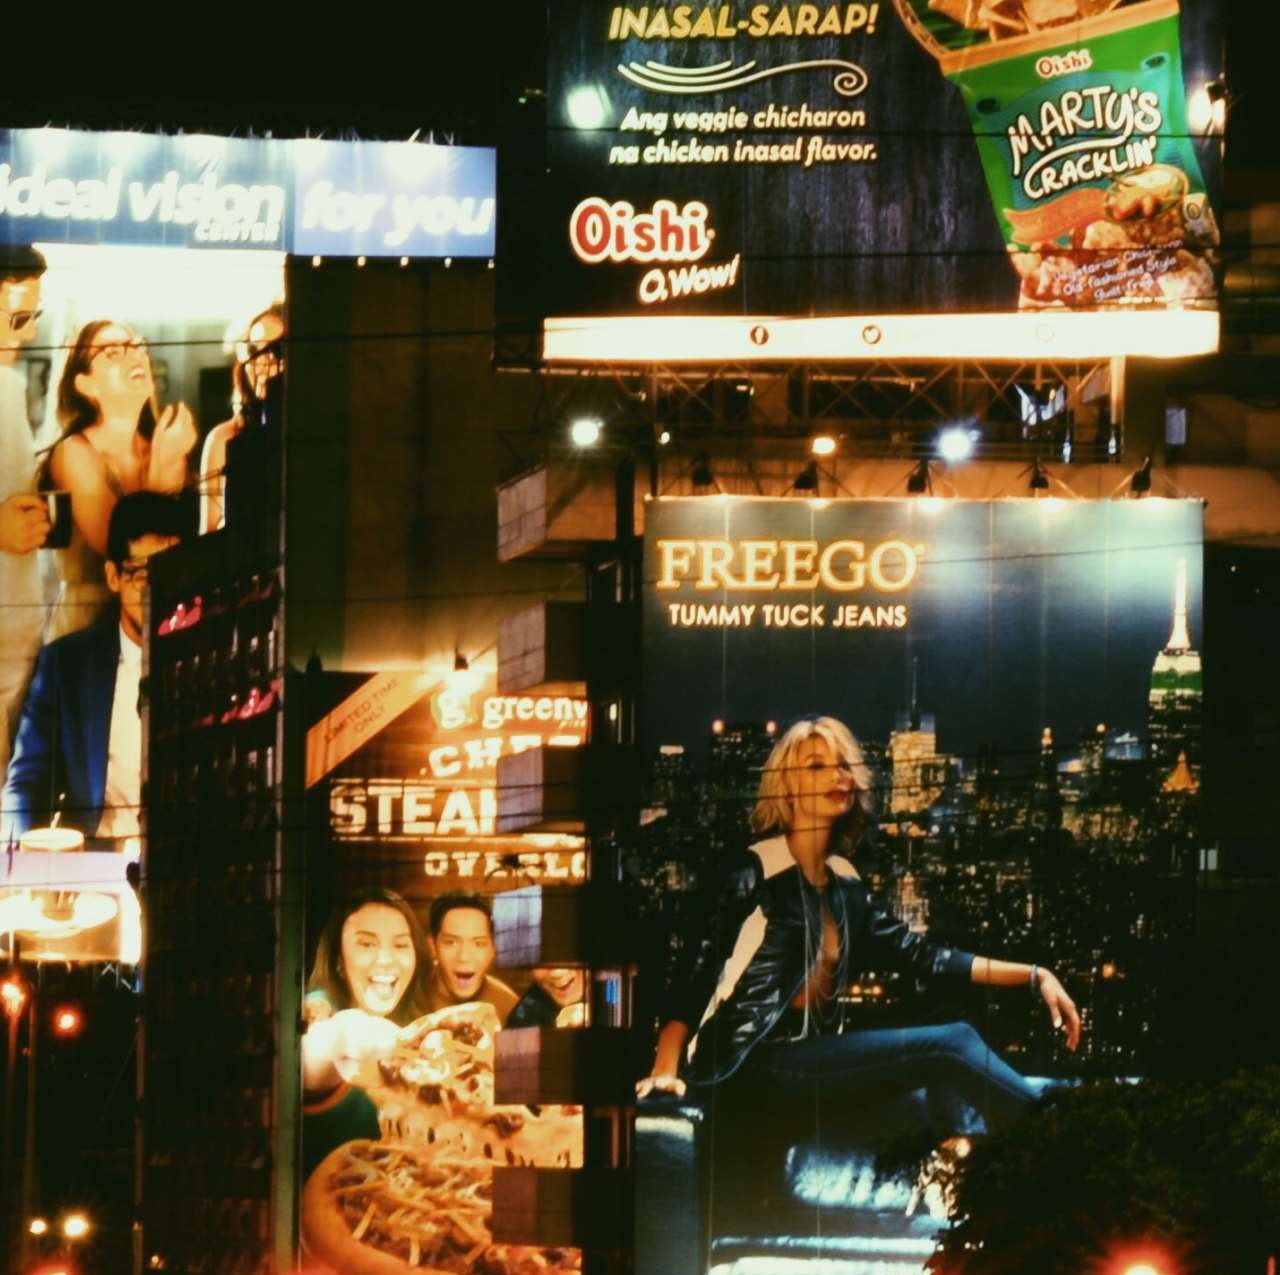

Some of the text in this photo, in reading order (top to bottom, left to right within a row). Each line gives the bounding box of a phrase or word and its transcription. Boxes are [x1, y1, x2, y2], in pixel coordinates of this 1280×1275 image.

[608, 3, 879, 40] INASAL-SARAP!
[1036, 48, 1093, 78] Oishi
[621, 104, 866, 136] Ang veggie chicharon
[609, 136, 878, 167] na chicken inasal flavor.
[128, 170, 285, 224] vision
[302, 179, 387, 232] for
[384, 192, 496, 247] you
[571, 198, 711, 262] Oishi
[656, 539, 922, 591] FREEGO
[668, 603, 908, 627] TUMMY TUCK JEANS
